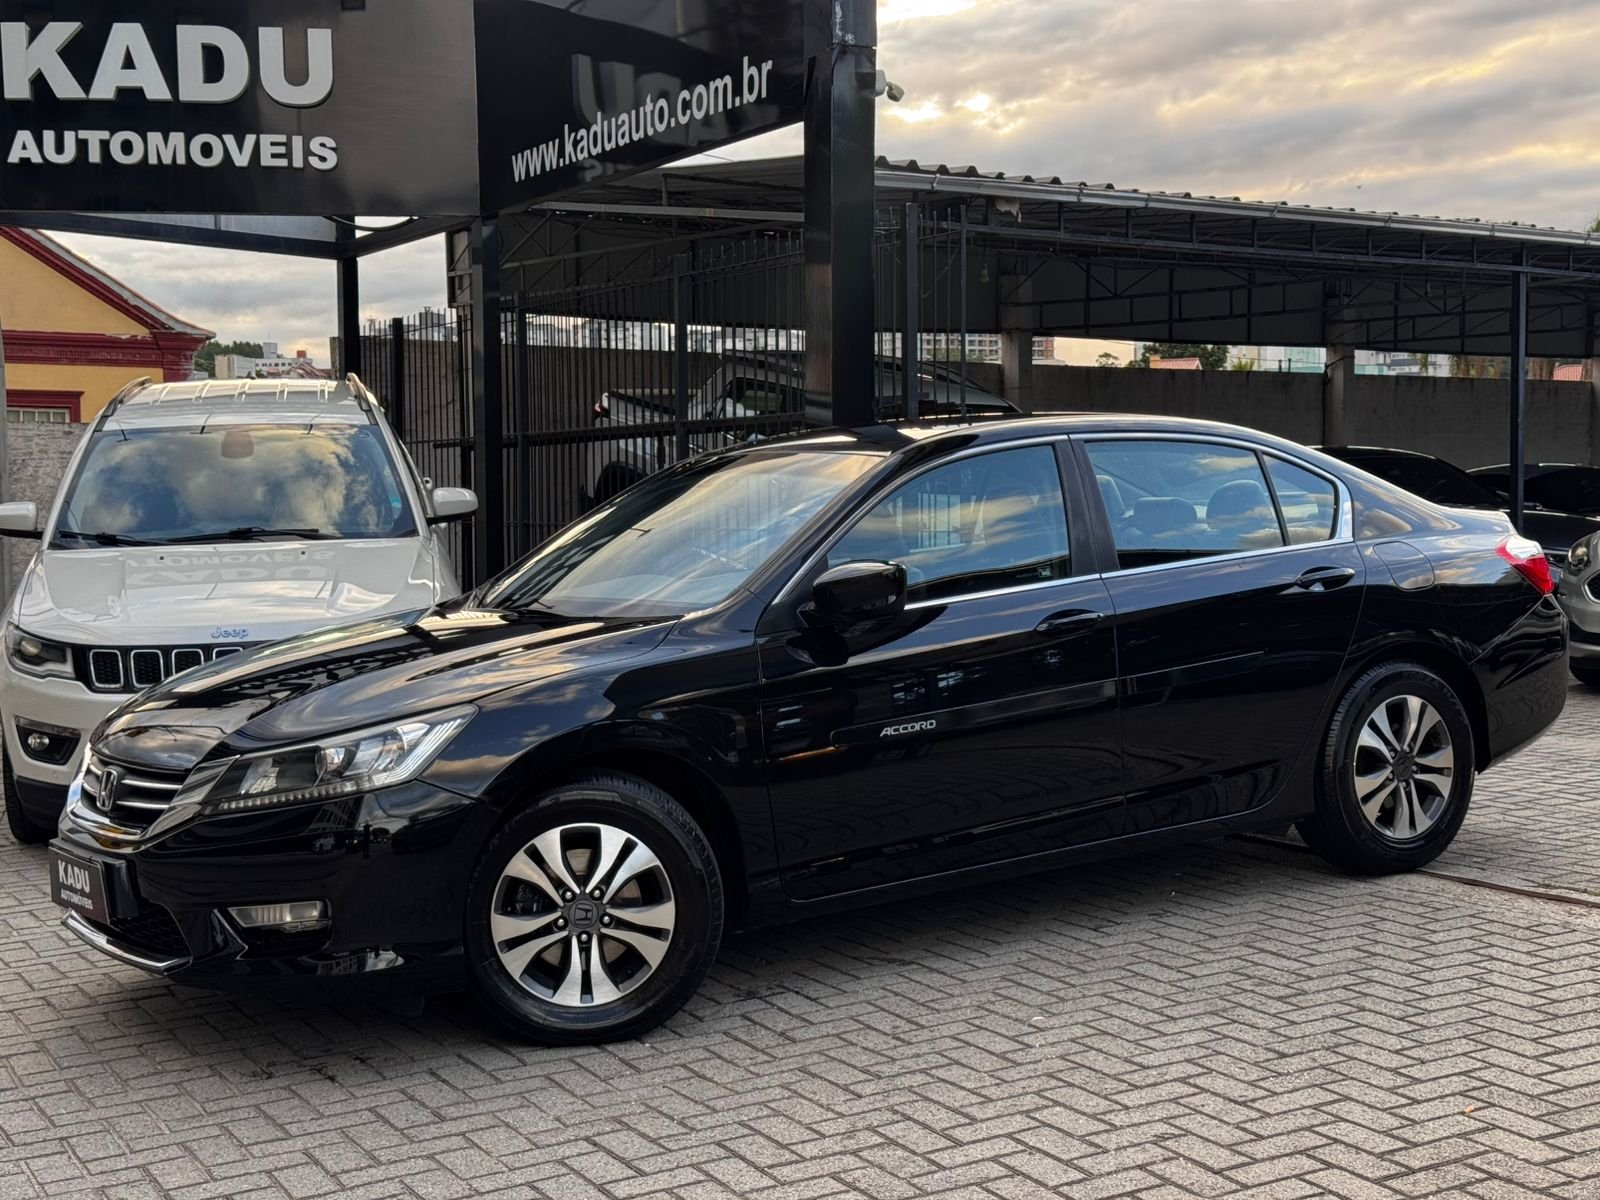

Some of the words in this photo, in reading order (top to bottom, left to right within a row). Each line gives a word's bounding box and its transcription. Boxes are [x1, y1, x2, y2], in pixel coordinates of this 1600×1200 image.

[1, 21, 334, 107] KADU
[511, 56, 773, 183] www.kaduauto.com.br
[7, 130, 338, 171] AUTOMOVEIS
[210, 626, 249, 639] Jeep
[880, 719, 937, 737] ACCORD
[58, 860, 90, 893] KADU
